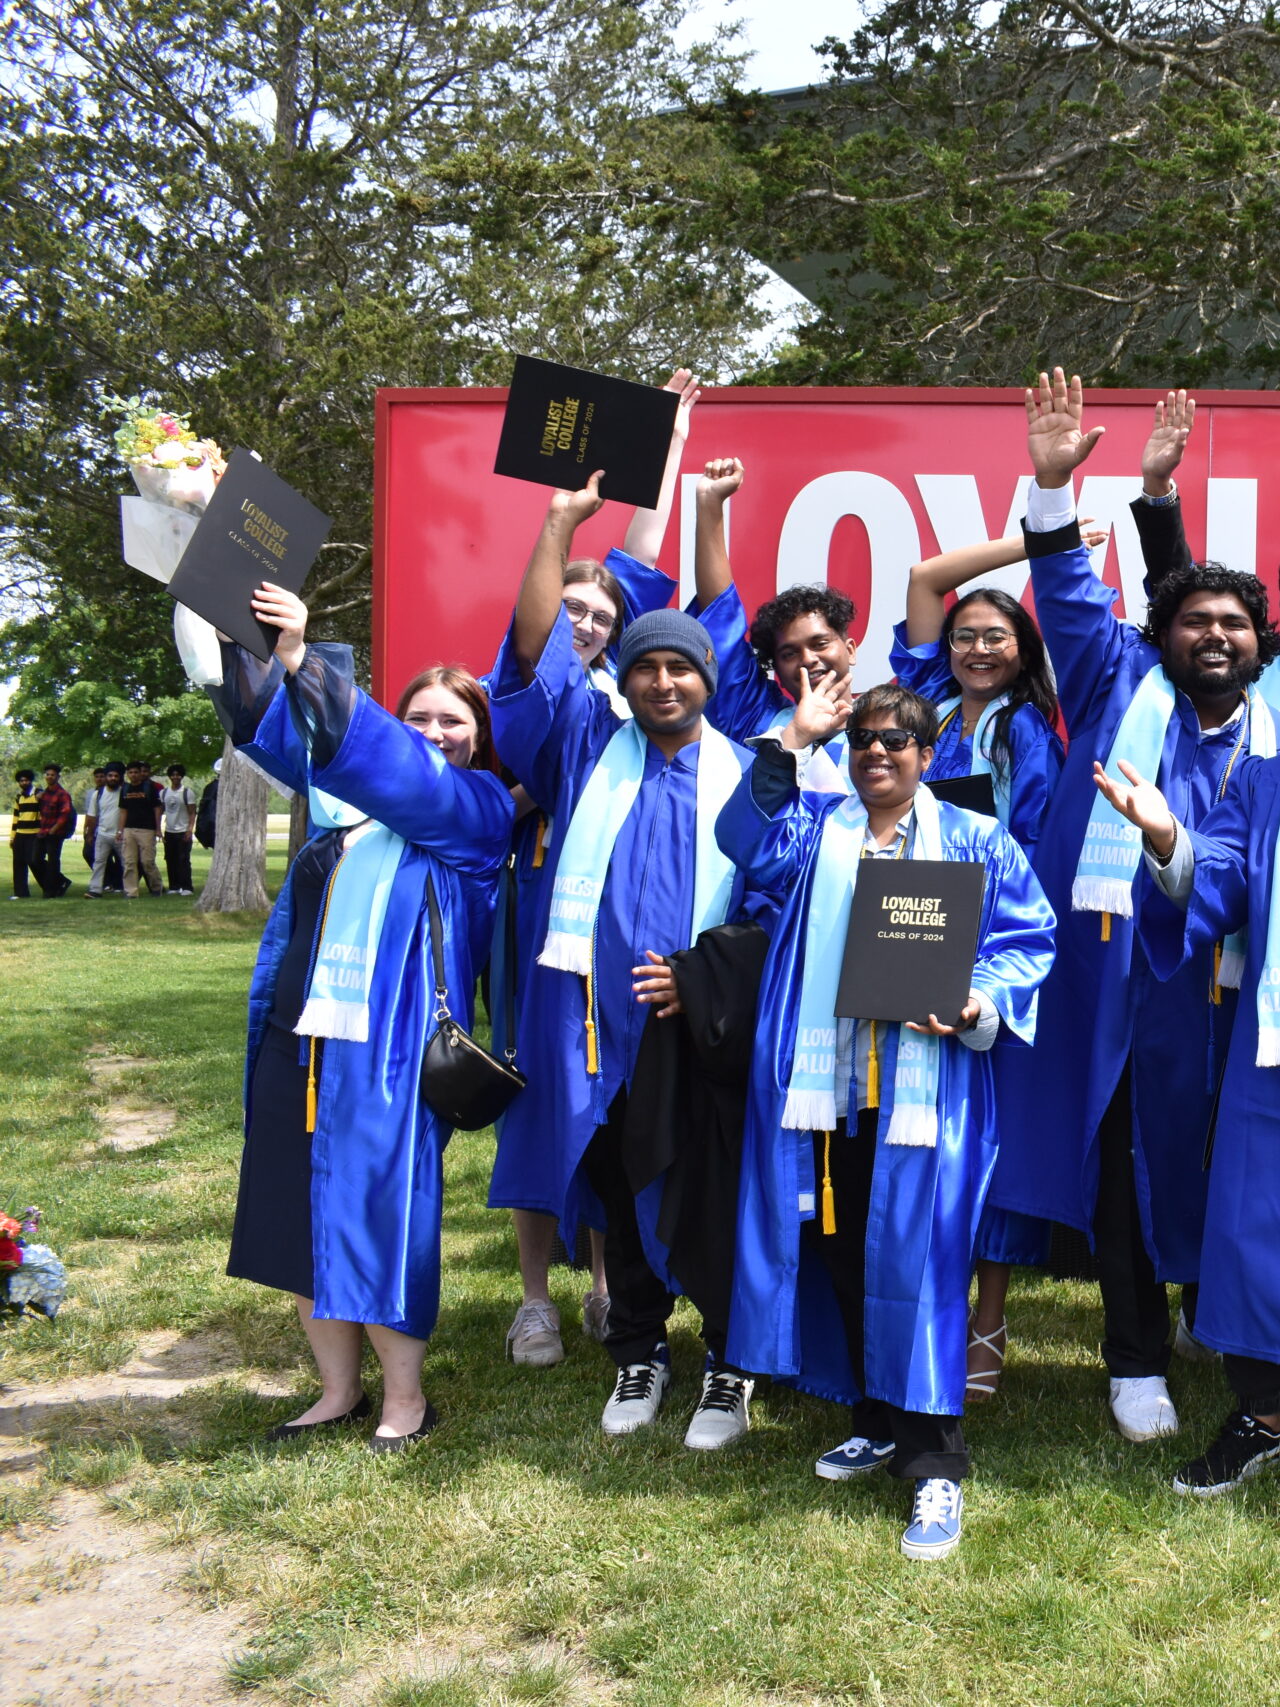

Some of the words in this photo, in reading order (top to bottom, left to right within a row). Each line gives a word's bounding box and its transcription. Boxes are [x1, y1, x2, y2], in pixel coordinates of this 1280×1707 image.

[585, 402, 594, 422] 2024
[540, 399, 564, 456] LOYALiST
[556, 396, 580, 450] COLLEGE
[582, 424, 591, 435] OF
[576, 437, 588, 463] CLASS
[244, 518, 287, 560] COLLEGE
[1085, 821, 1143, 844] OYALiST
[881, 895, 942, 912] LOYALiST
[890, 910, 948, 927] COLLEGE
[877, 931, 906, 940] CLASS
[908, 932, 921, 940] OF
[923, 934, 944, 942] 2024
[795, 1053, 836, 1074] ALU
